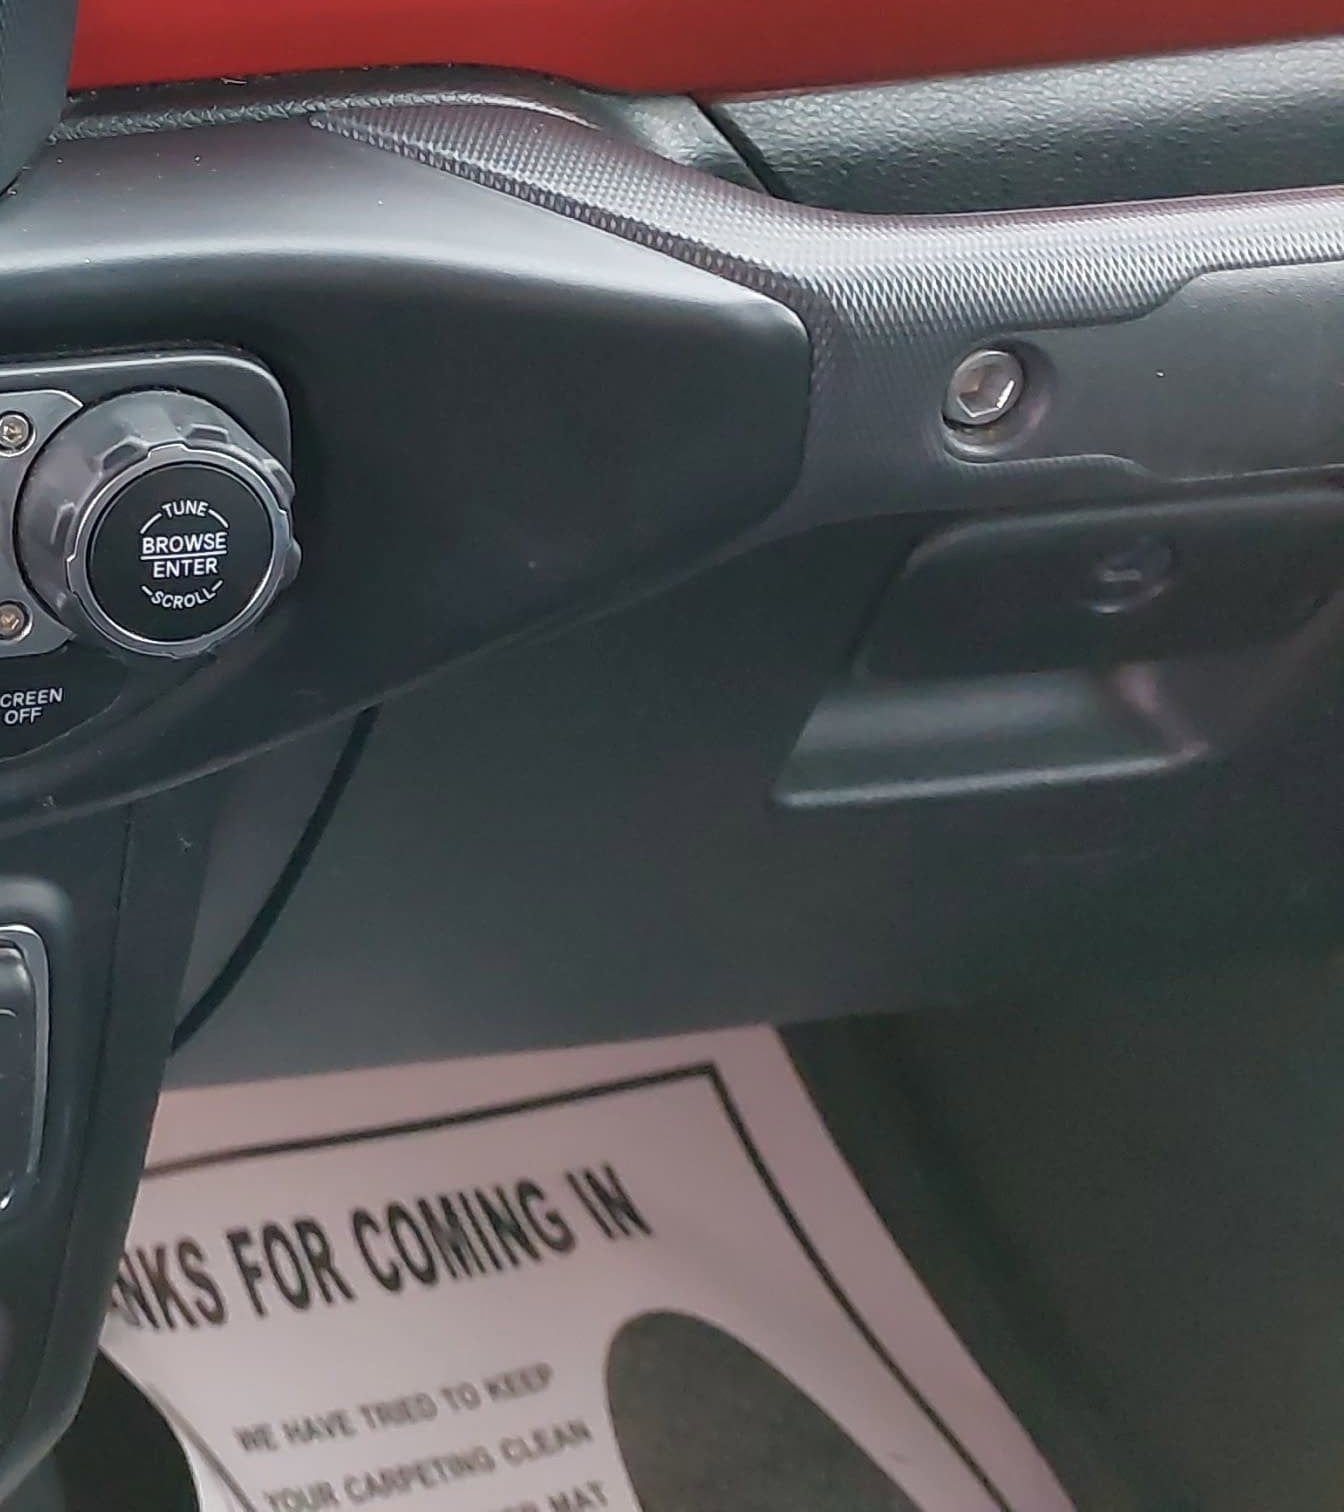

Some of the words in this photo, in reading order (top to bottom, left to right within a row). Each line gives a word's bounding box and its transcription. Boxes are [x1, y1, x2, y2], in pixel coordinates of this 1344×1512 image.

[162, 500, 209, 520] TUNE
[142, 532, 227, 555] BROWSE
[153, 558, 218, 578] ENTER
[149, 587, 217, 609] SCROLL
[4, 707, 41, 726] OFF
[111, 1236, 225, 1328] NKS
[226, 1215, 355, 1318] FOR
[351, 1178, 575, 1294] COMING
[568, 1162, 653, 1237] IN
[233, 1423, 278, 1453] WE
[282, 1409, 356, 1445] HAVE
[358, 1391, 438, 1429] TRIED
[440, 1382, 482, 1412] TO
[484, 1363, 554, 1402] KEEP
[343, 1445, 496, 1505] CARPETING
[498, 1418, 593, 1466] CLEAN
